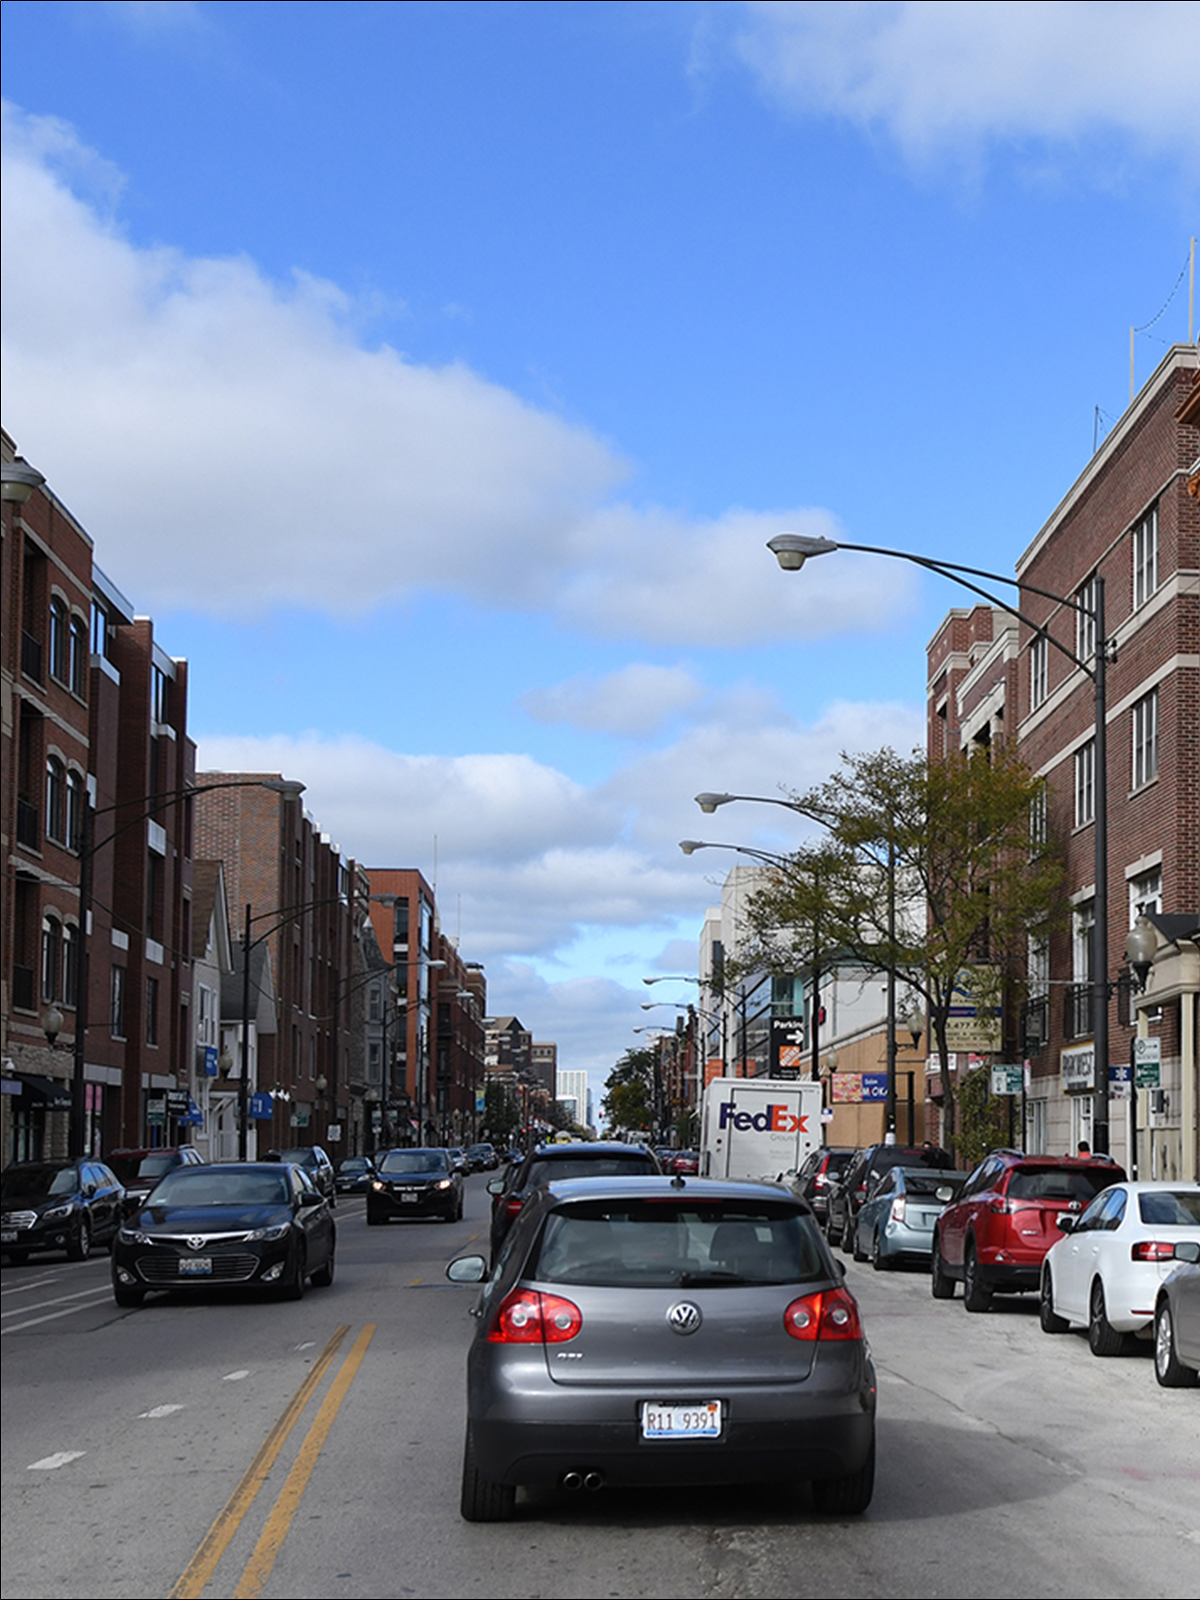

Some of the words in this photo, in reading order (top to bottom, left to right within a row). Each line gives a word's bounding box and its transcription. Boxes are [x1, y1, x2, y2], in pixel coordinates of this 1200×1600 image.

[719, 1102, 809, 1133] FedEx
[647, 1412, 673, 1430] R11
[682, 1412, 716, 1430] 9391
